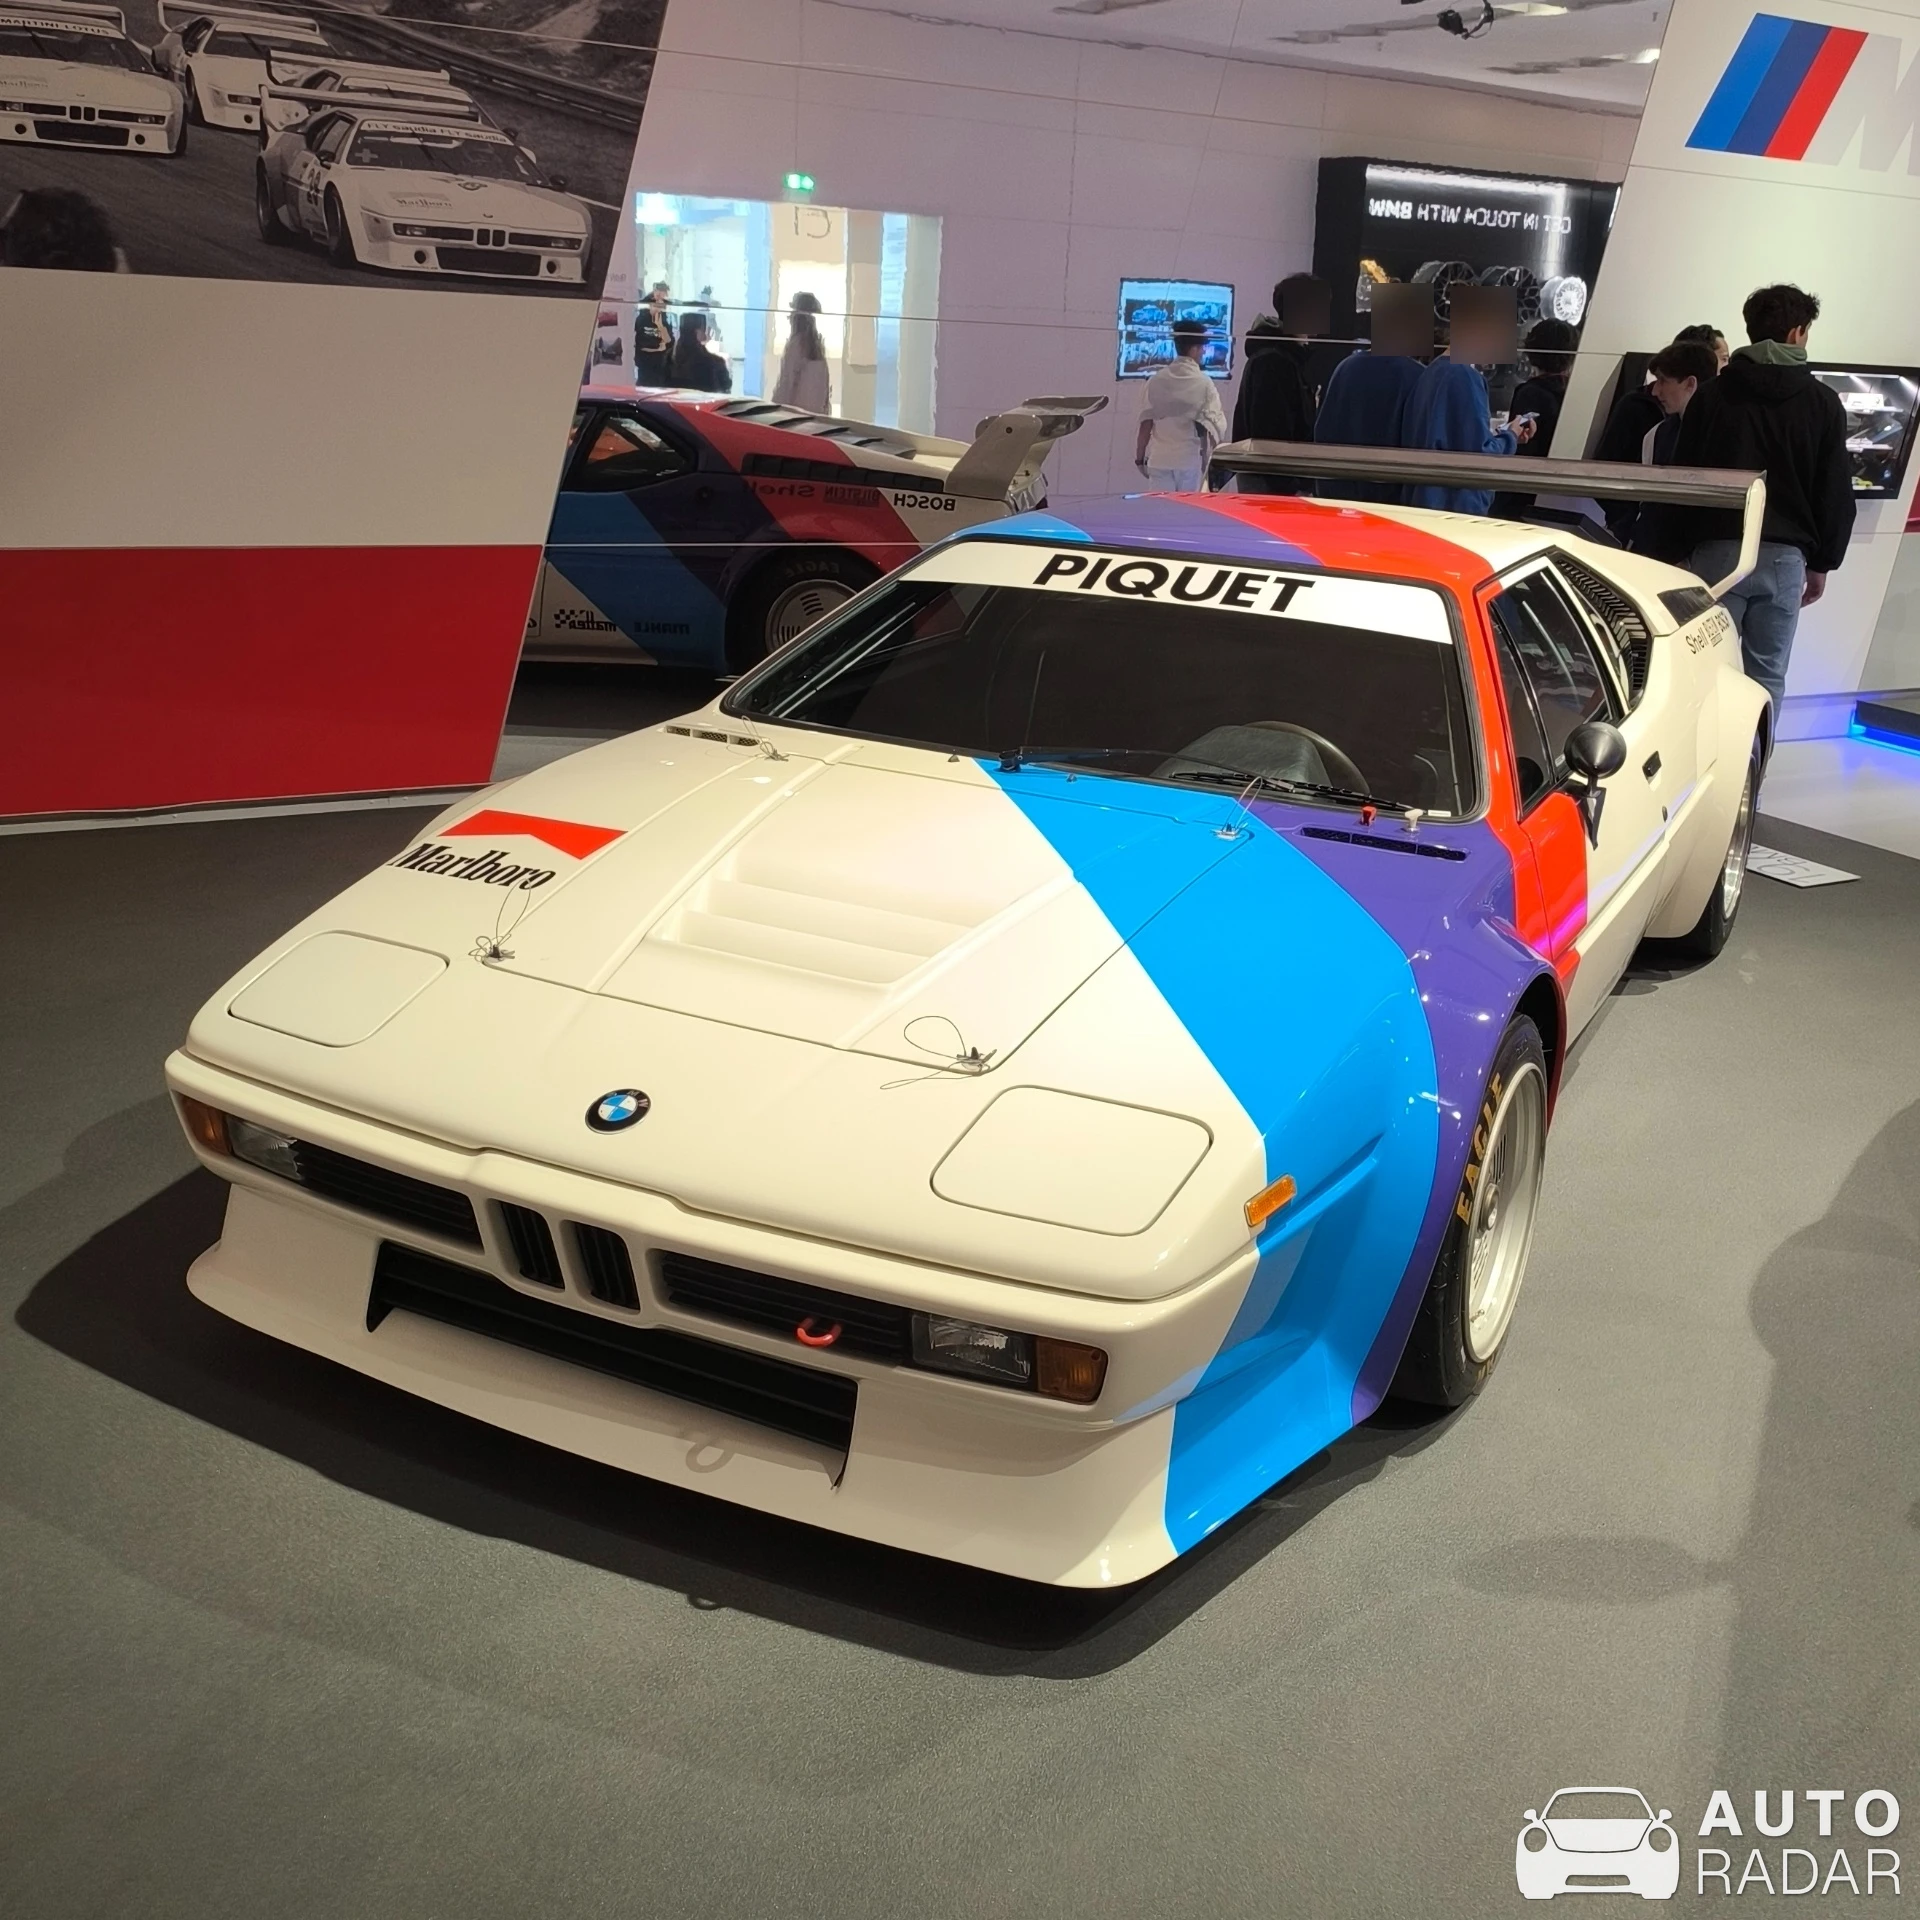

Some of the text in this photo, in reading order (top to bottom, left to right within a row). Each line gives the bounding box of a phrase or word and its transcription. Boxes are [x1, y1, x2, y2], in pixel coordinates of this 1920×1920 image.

[367, 122, 389, 130] FLY
[440, 127, 460, 137] FLY
[1032, 553, 1316, 613] PIQUET
[1685, 627, 1709, 654] Shell
[387, 843, 556, 890] Marlboro
[1456, 1072, 1503, 1226] EAGLE
